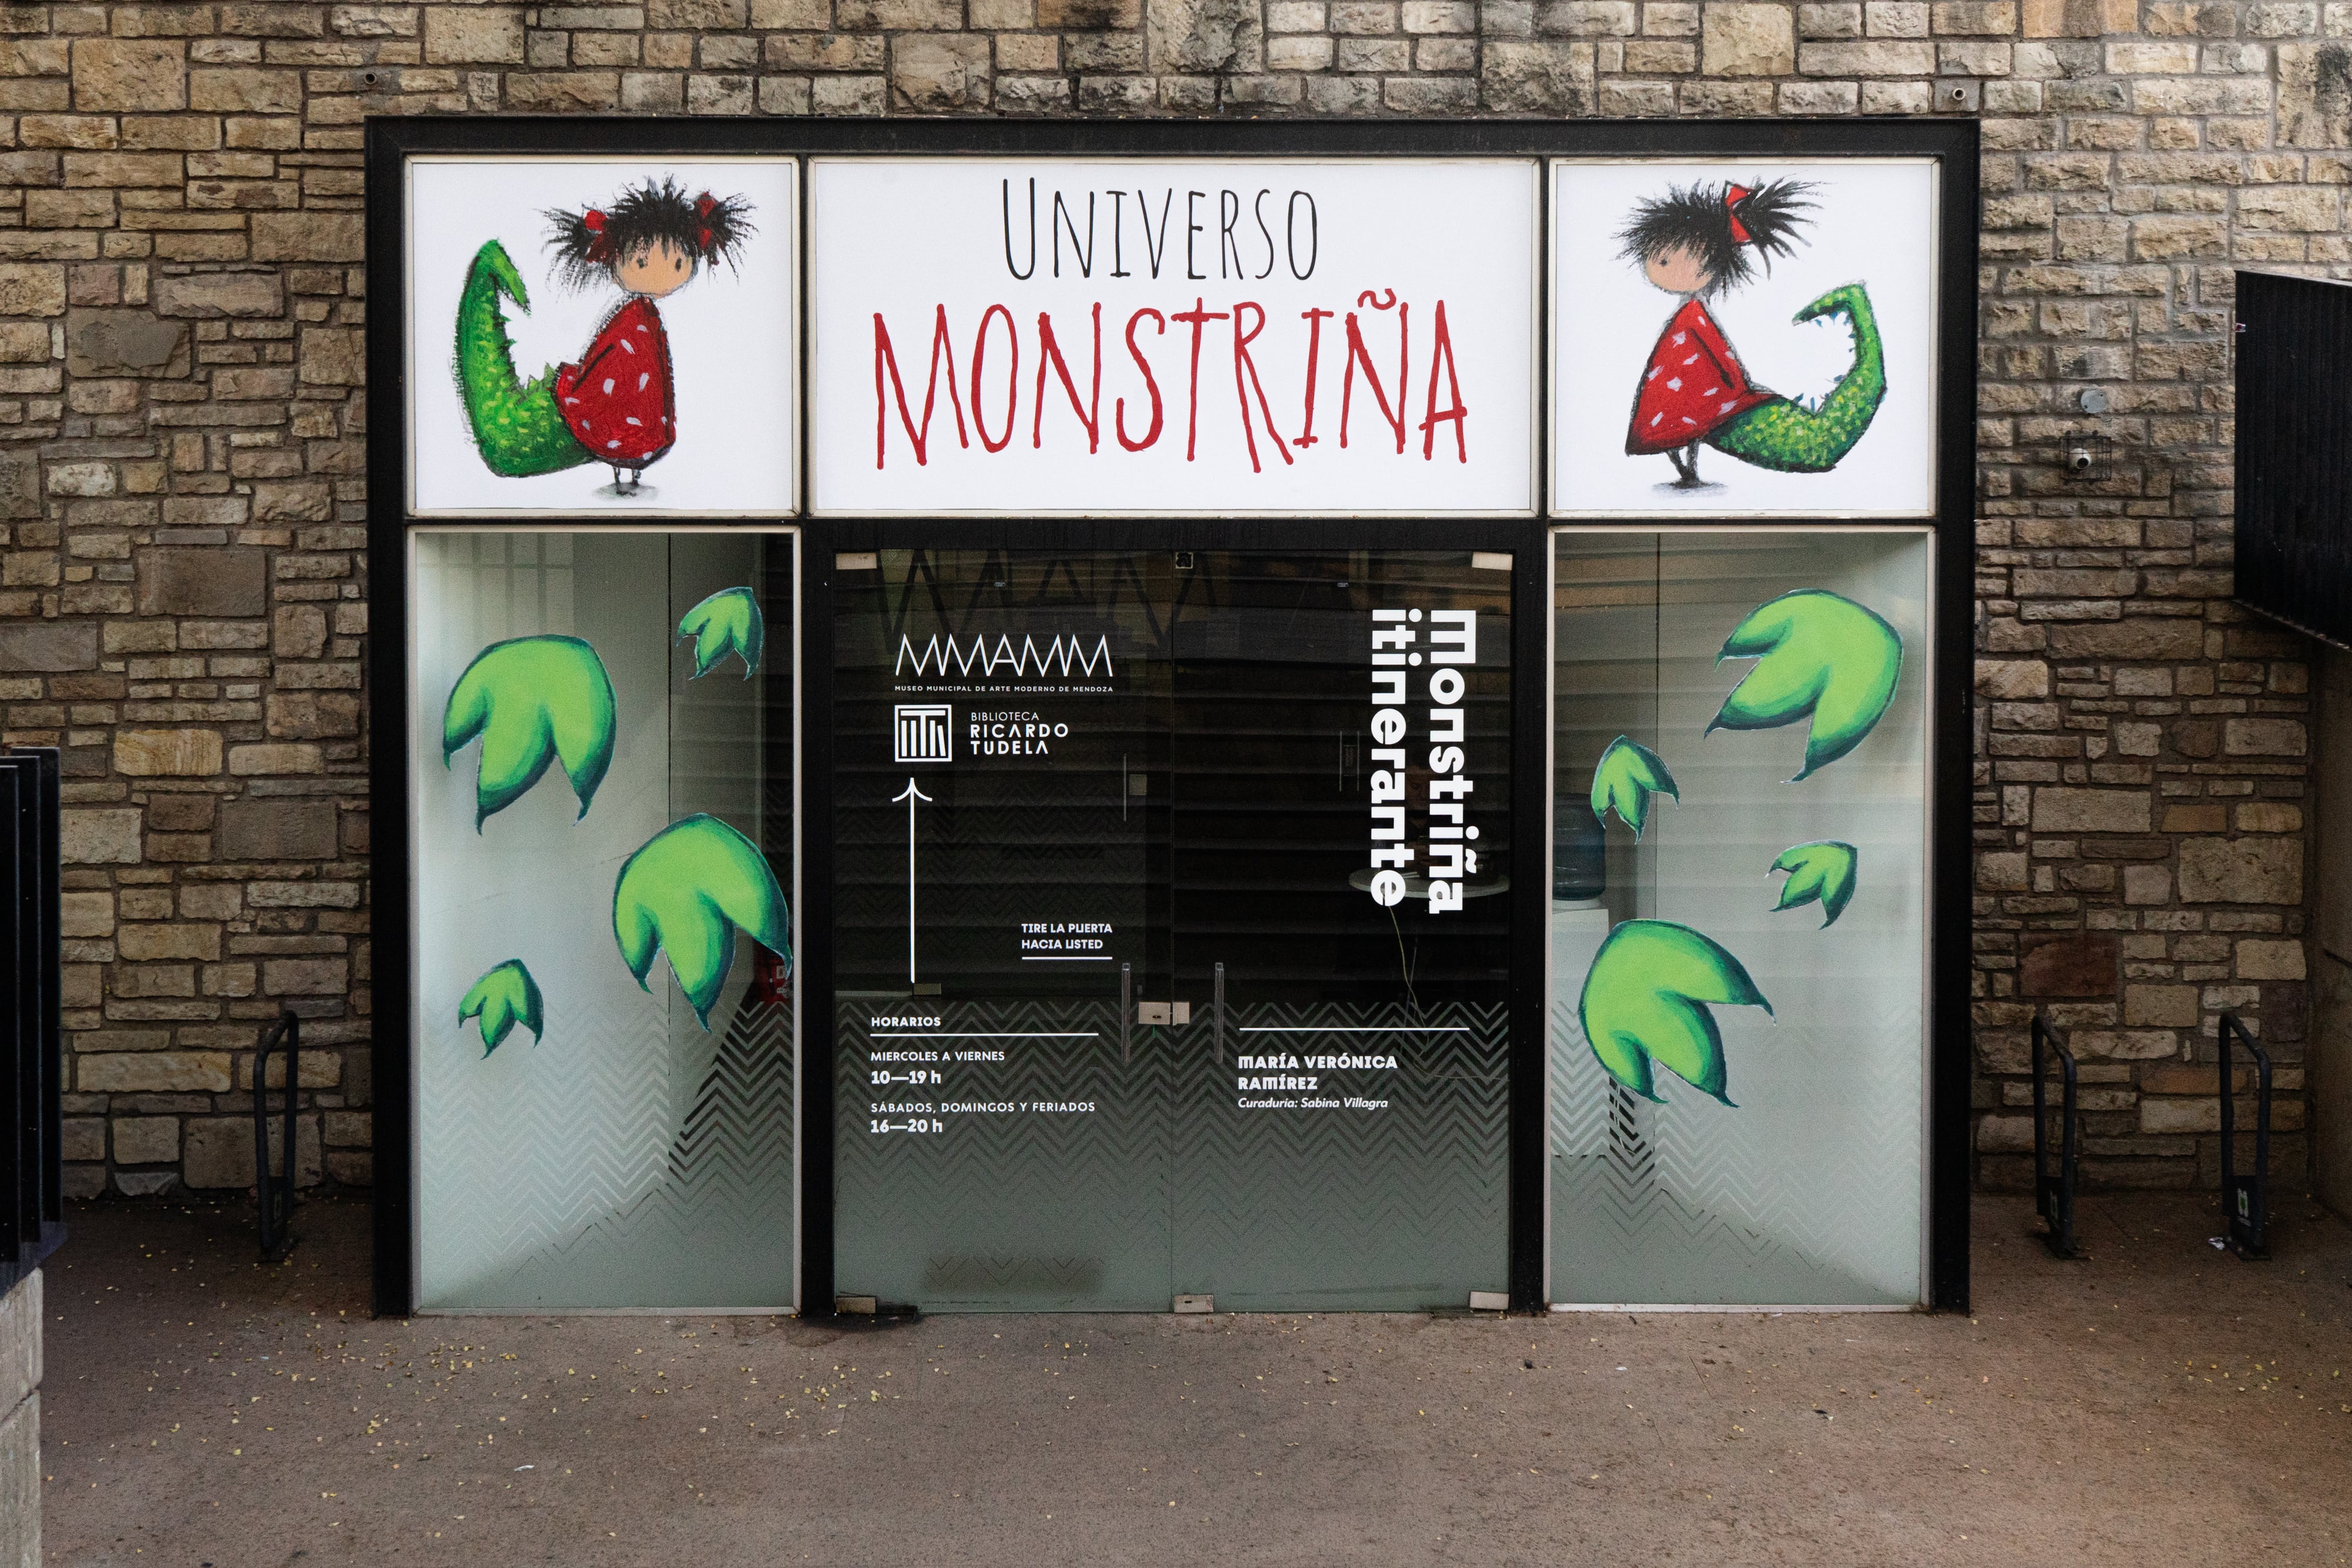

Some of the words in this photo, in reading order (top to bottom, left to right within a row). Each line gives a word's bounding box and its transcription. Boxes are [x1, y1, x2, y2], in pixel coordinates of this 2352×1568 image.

[1003, 177, 1317, 280] UNIVERSO
[873, 288, 1468, 473] MONSTRIÑA
[896, 633, 1113, 678] MMAMM
[971, 711, 1040, 721] BIBLIOTECA
[970, 723, 1068, 738] RICARDO
[970, 740, 1048, 755] TUDELA
[1370, 608, 1422, 907] itinerante
[1021, 923, 1047, 933] TIRE
[1050, 923, 1065, 933] LA
[1068, 923, 1112, 933] PUERTA
[1021, 939, 1063, 949] HACIA
[1065, 939, 1103, 949] USTED
[871, 1017, 941, 1027] HORARIOS
[871, 1051, 938, 1061] MIERCOLES
[942, 1051, 951, 1061] A
[954, 1051, 1005, 1061] VIERNES
[1238, 1052, 1299, 1069] MARÍA
[1304, 1052, 1398, 1069] VERÓNICA
[931, 1070, 941, 1084] h
[1238, 1074, 1318, 1090] RAMÍREZ
[871, 1101, 936, 1114] SÁBADOS,
[941, 1102, 1014, 1112] DOMINGOS
[1020, 1102, 1027, 1112] Y
[1033, 1102, 1095, 1112] FERIADOS
[1238, 1097, 1298, 1108] Curaduría:
[1301, 1097, 1340, 1108] Sabina
[1344, 1097, 1388, 1111] Villagra
[933, 1118, 943, 1133] h
